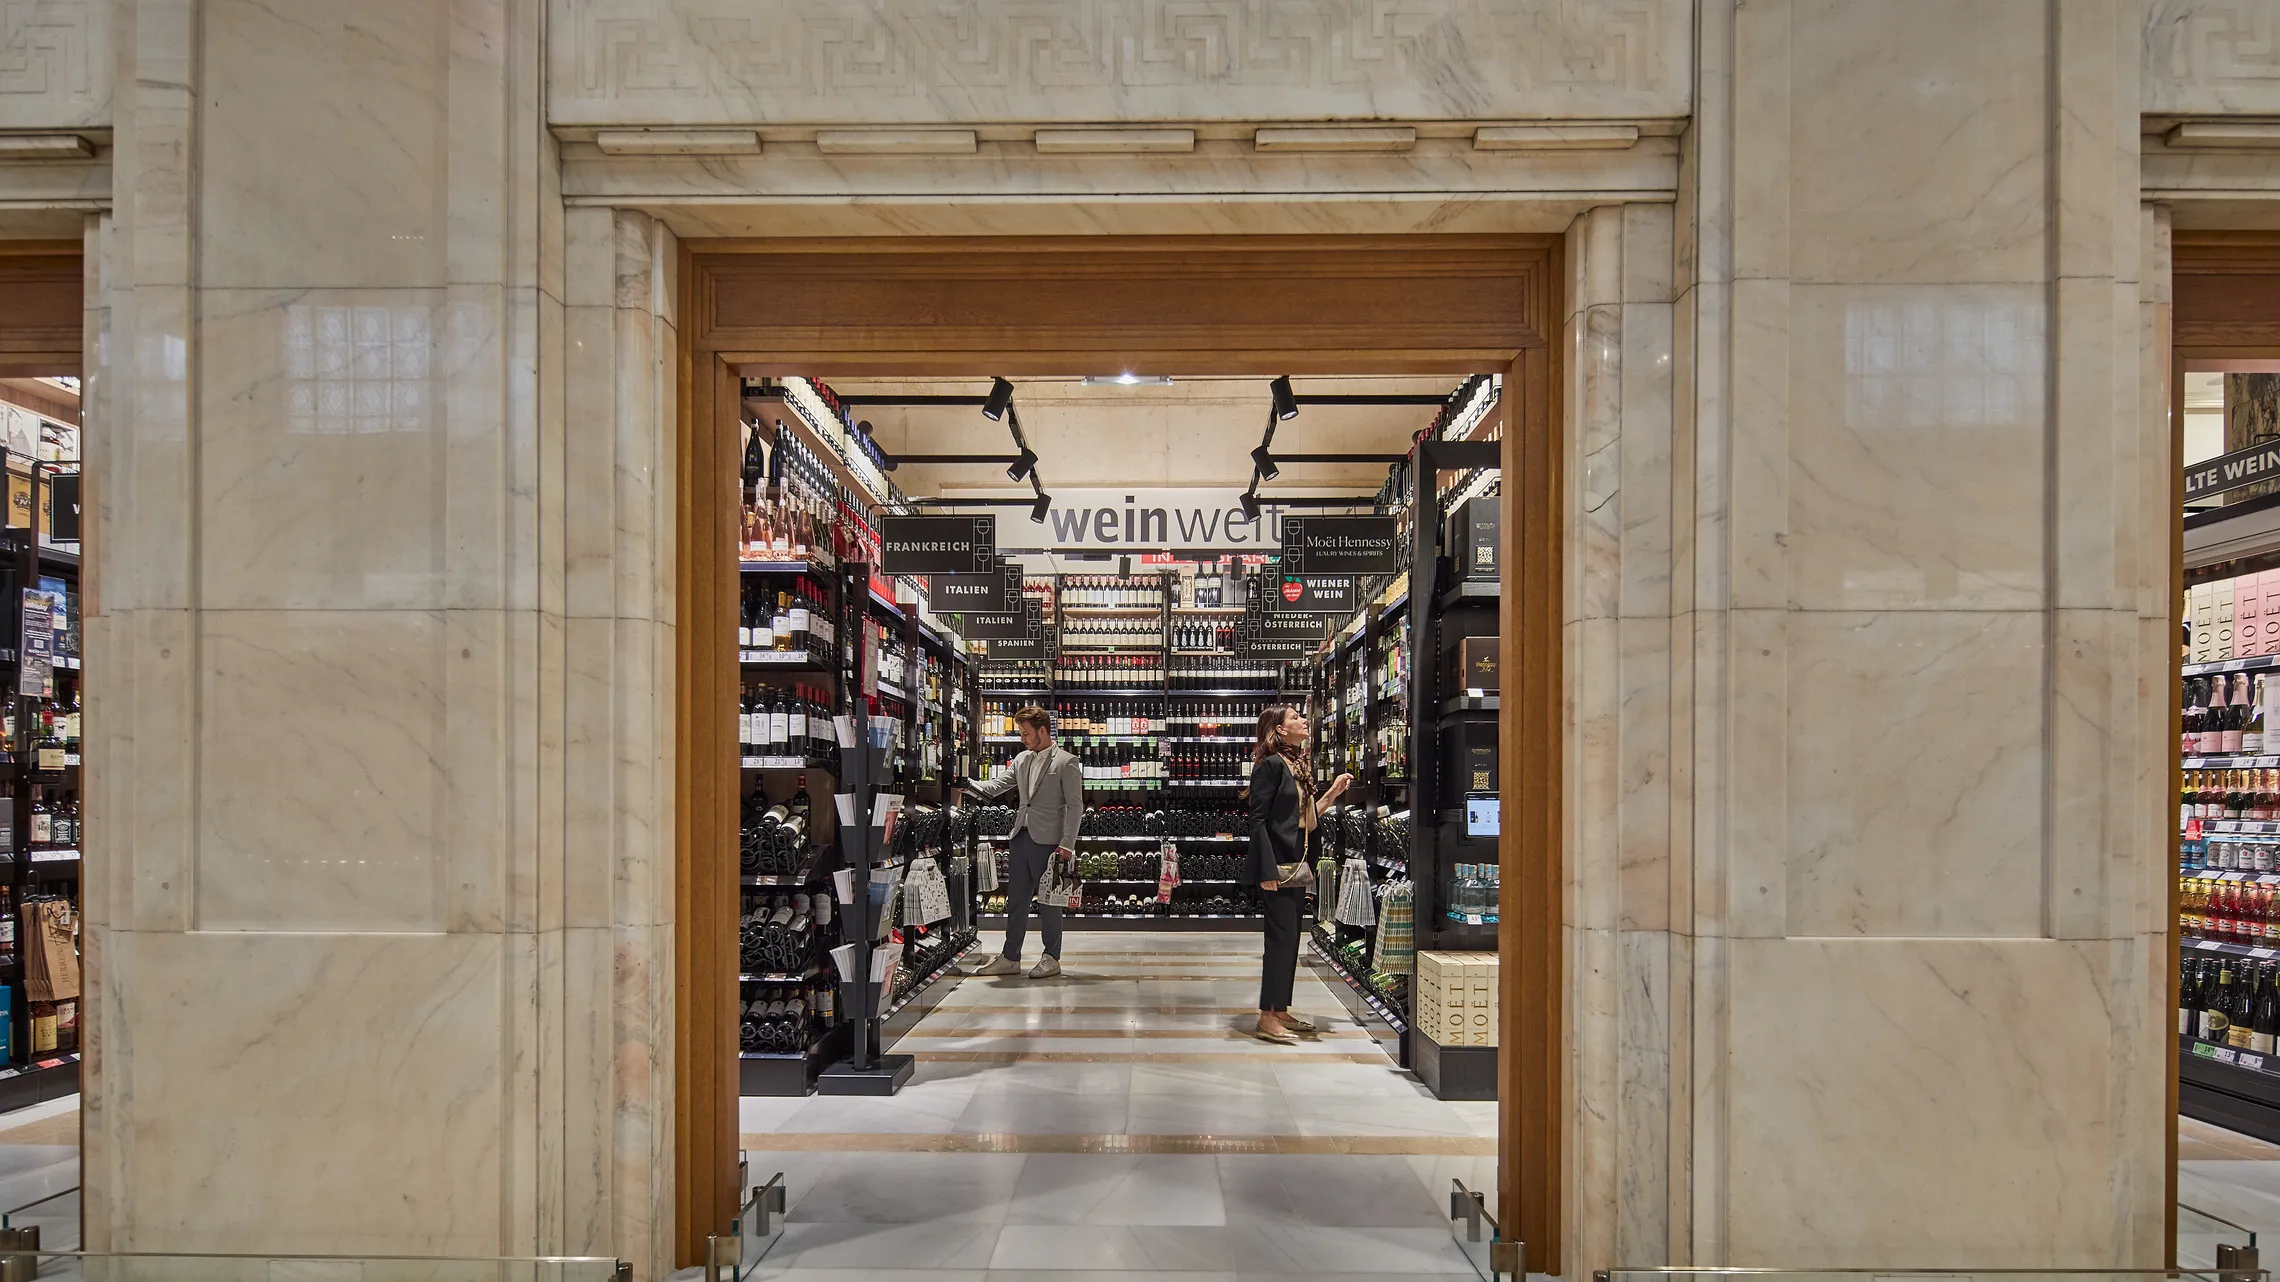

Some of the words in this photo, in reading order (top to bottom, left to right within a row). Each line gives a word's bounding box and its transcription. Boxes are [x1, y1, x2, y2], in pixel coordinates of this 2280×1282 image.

[886, 541, 970, 552] FRANKREICH
[1307, 535, 1337, 548] Moët
[1338, 535, 1393, 550] Hennessy
[1306, 579, 1350, 588] WIENER
[945, 585, 989, 595] ITALIEN
[1313, 590, 1343, 599] WEIN
[976, 616, 1013, 625] ITALIEN
[1264, 619, 1323, 629] ÖSTERREICH
[2217, 600, 2233, 660] MOËT
[2240, 596, 2257, 656] MOËT
[2195, 604, 2211, 662] MOËT
[997, 639, 1034, 647] SPANIEN
[1250, 642, 1301, 650] ÖSTERREICH
[1447, 984, 1465, 1045] MOËT
[1470, 984, 1488, 1045] MOËT
